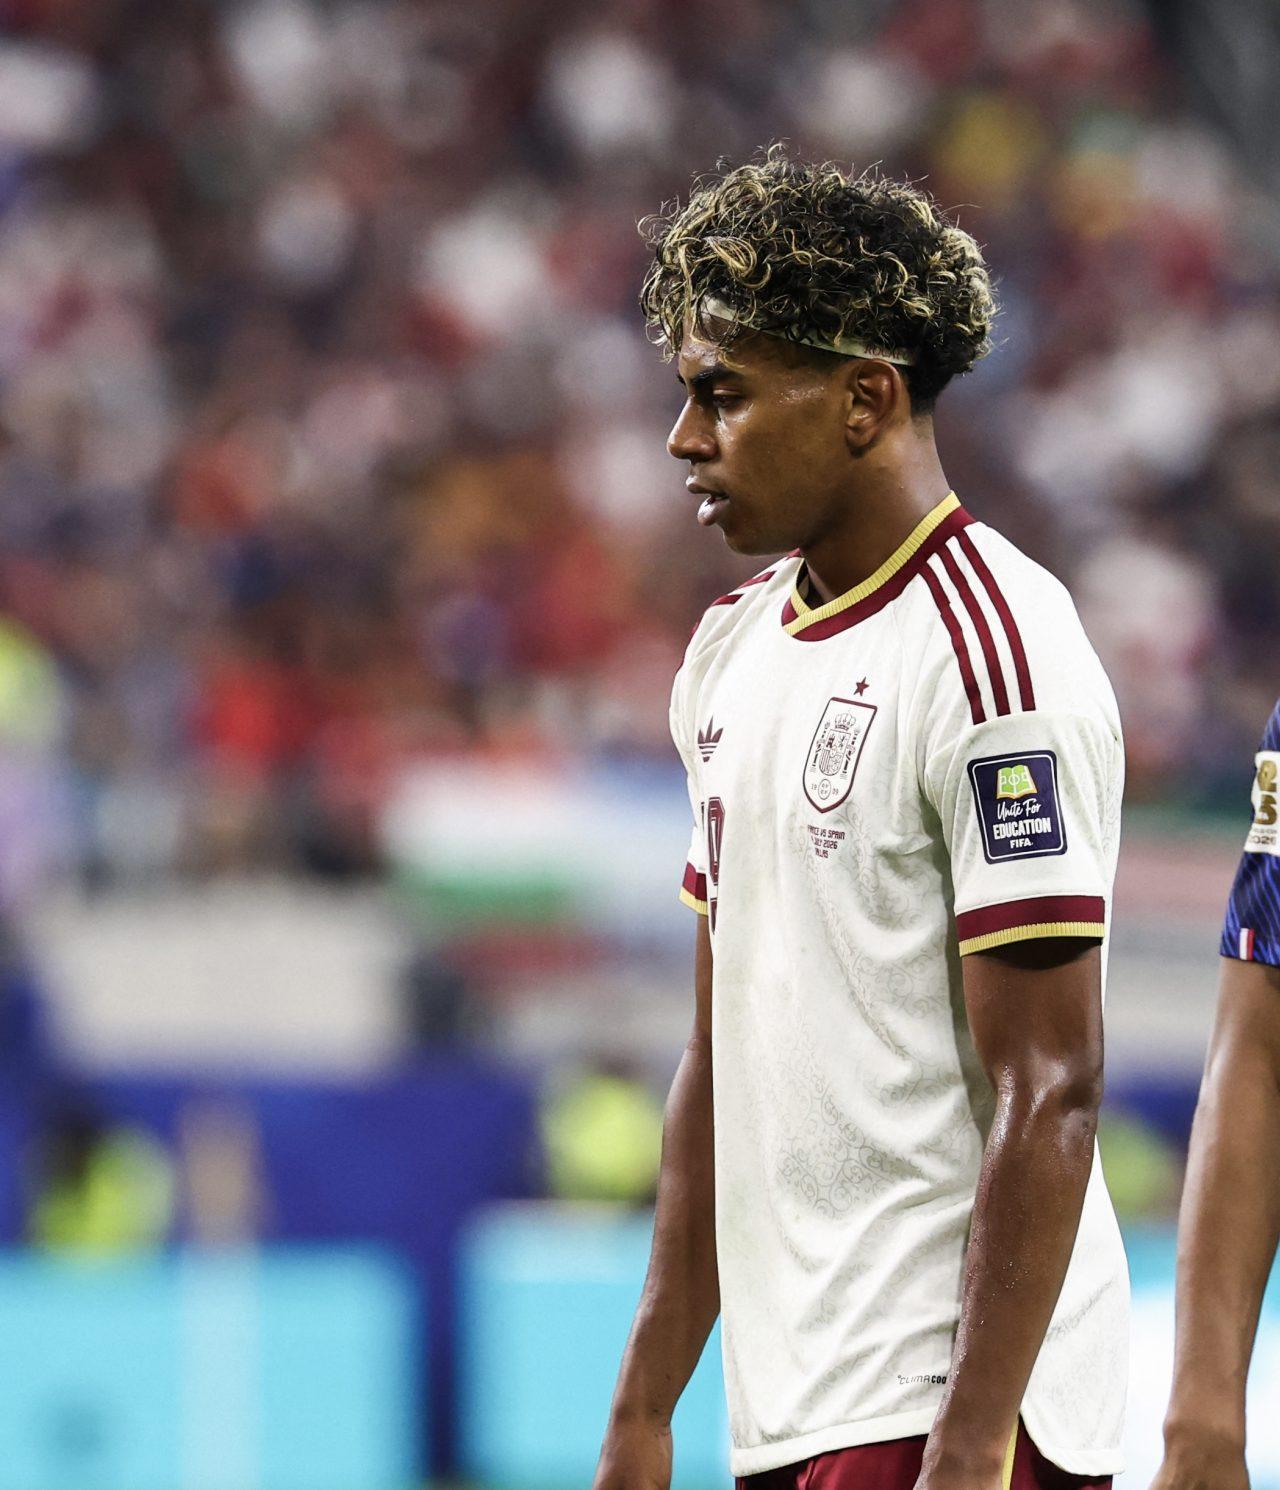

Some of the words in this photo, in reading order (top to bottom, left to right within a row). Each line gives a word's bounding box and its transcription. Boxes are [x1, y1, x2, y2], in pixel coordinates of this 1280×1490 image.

[997, 801, 1023, 822] Unite
[1022, 798, 1042, 818] For
[993, 817, 1052, 840] EDUCATION
[1010, 837, 1032, 849] FIFA
